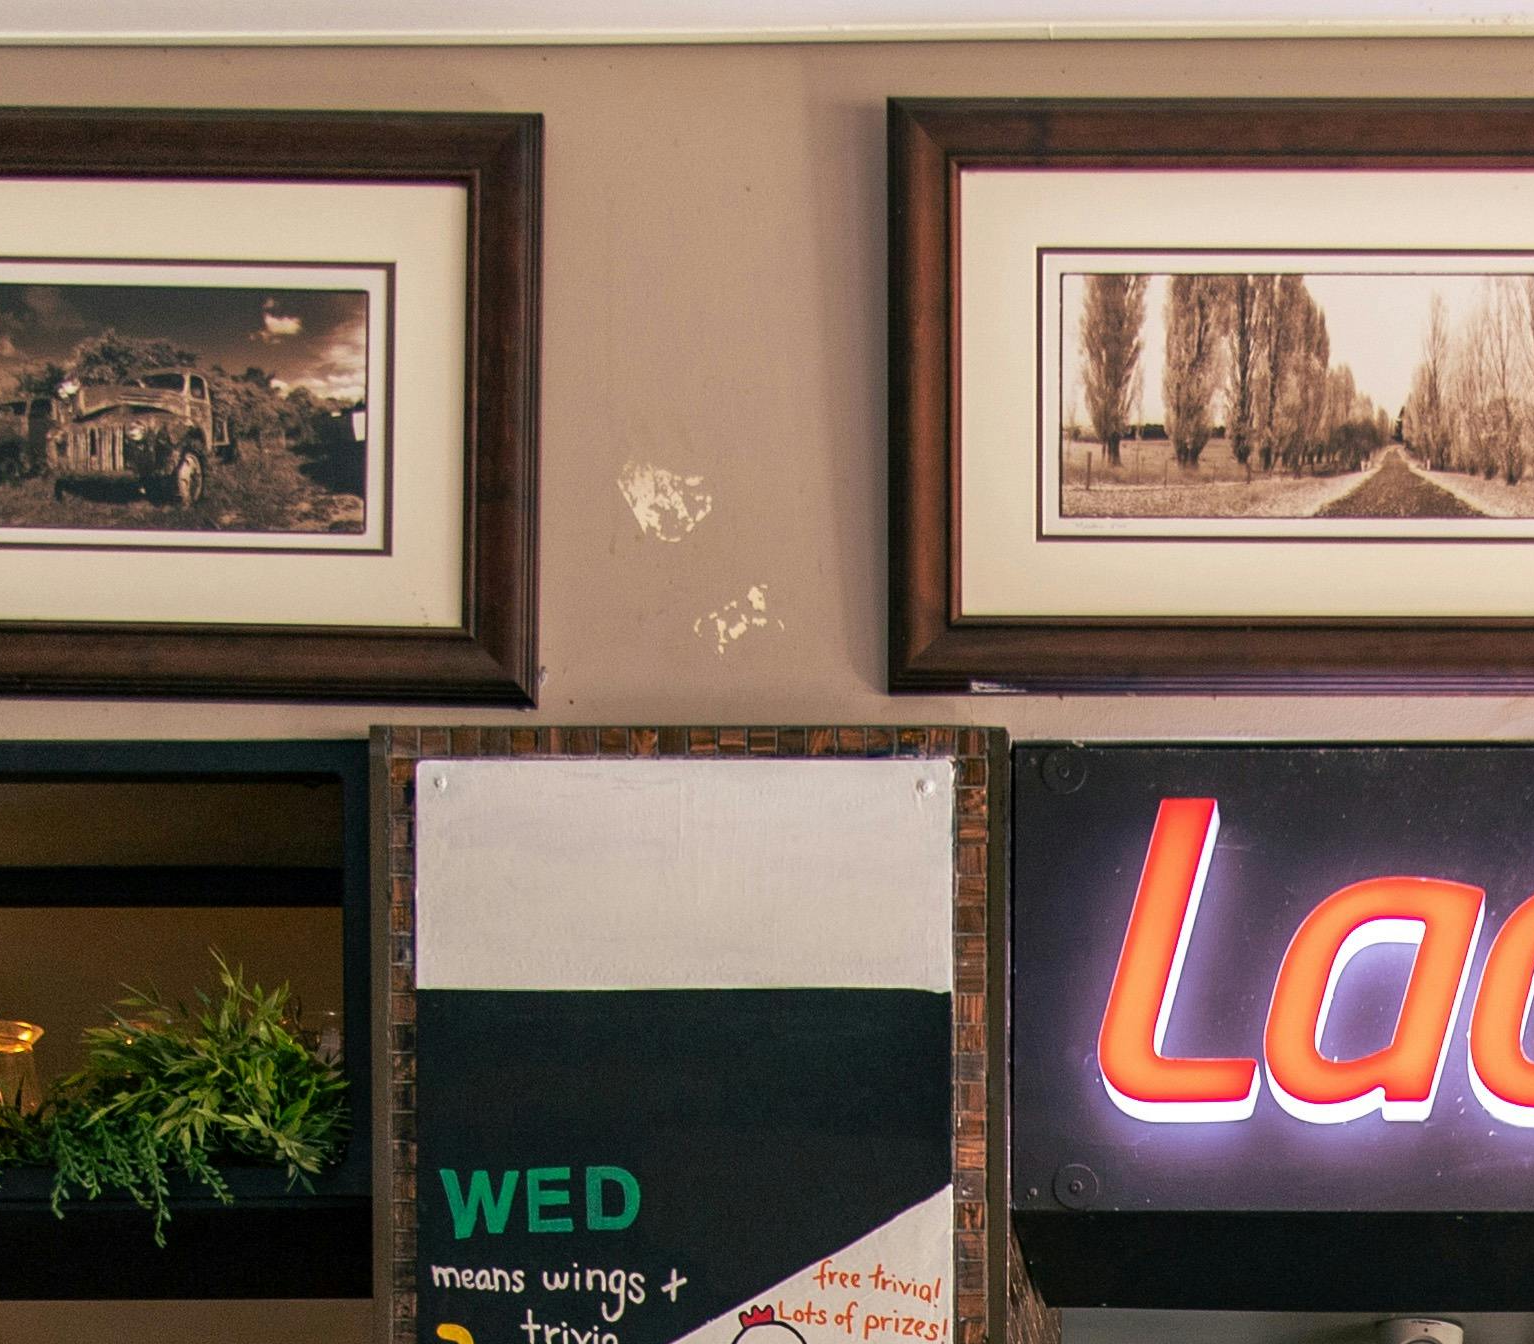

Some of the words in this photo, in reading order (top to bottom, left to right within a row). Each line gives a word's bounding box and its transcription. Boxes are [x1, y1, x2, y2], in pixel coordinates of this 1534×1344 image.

[439, 1165, 642, 1240] WED
[431, 1264, 525, 1291] means
[542, 1264, 646, 1322] wings
[812, 1259, 862, 1291] free
[867, 1263, 942, 1309] trivia!
[833, 1301, 854, 1334] of
[864, 1309, 949, 1344] prizes!
